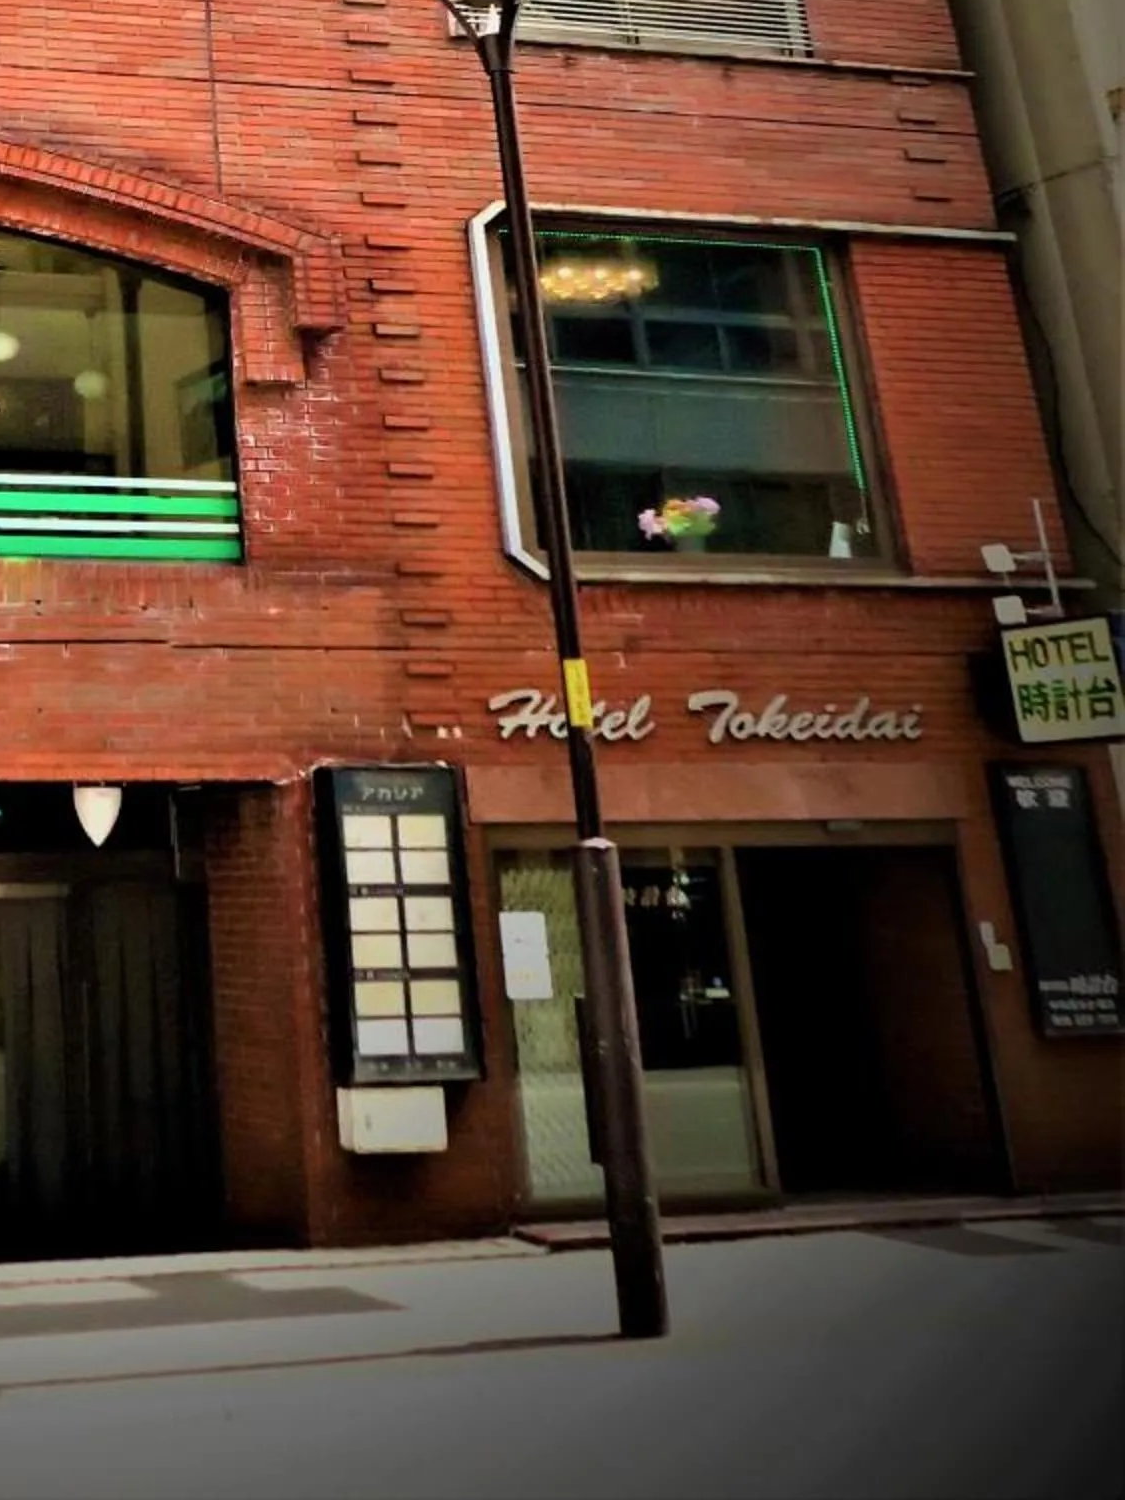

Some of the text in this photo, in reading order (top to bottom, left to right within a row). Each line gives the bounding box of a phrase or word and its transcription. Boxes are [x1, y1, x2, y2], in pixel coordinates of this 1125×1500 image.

[1008, 631, 1110, 672] HOTEL
[688, 689, 923, 743] Tokeidai
[1017, 676, 1117, 722] 時計台
